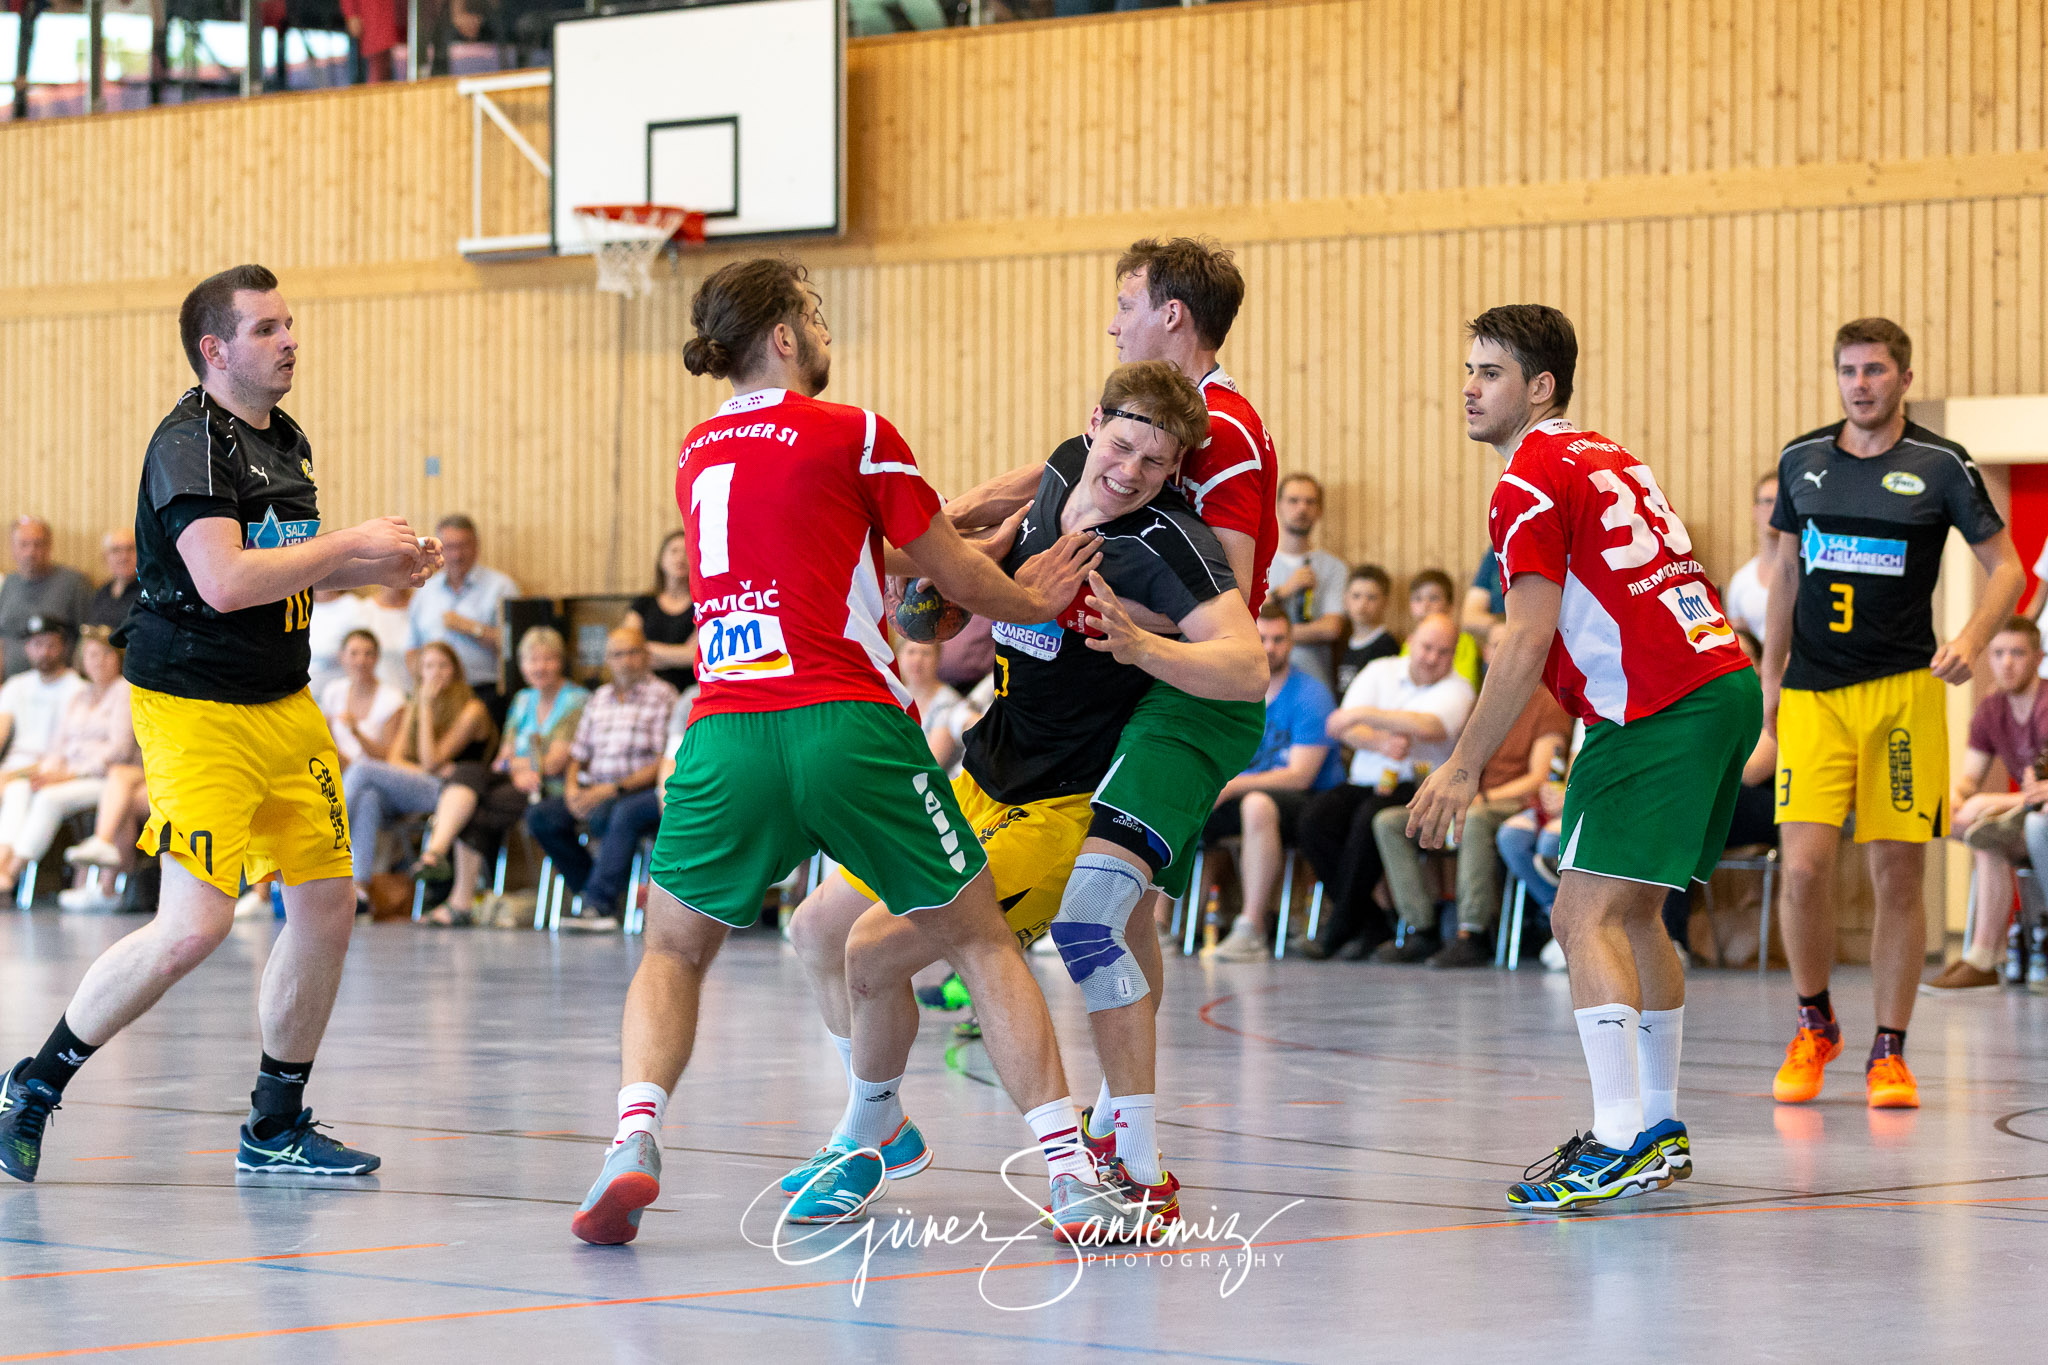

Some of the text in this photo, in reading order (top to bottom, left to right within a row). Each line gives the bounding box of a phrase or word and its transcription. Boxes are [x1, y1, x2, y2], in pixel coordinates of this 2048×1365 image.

[285, 522, 309, 538] SALZ
[690, 462, 737, 579] 1
[1587, 464, 1693, 572] 33
[1826, 548, 1902, 568] HELMREICH
[1828, 536, 1859, 552] SALZ
[1674, 586, 1712, 622] dm
[1828, 582, 1855, 634] 3
[707, 618, 763, 666] dm
[1778, 768, 1792, 807] 3
[1899, 739, 1914, 801] MEIER
[1112, 817, 1143, 834] adidas
